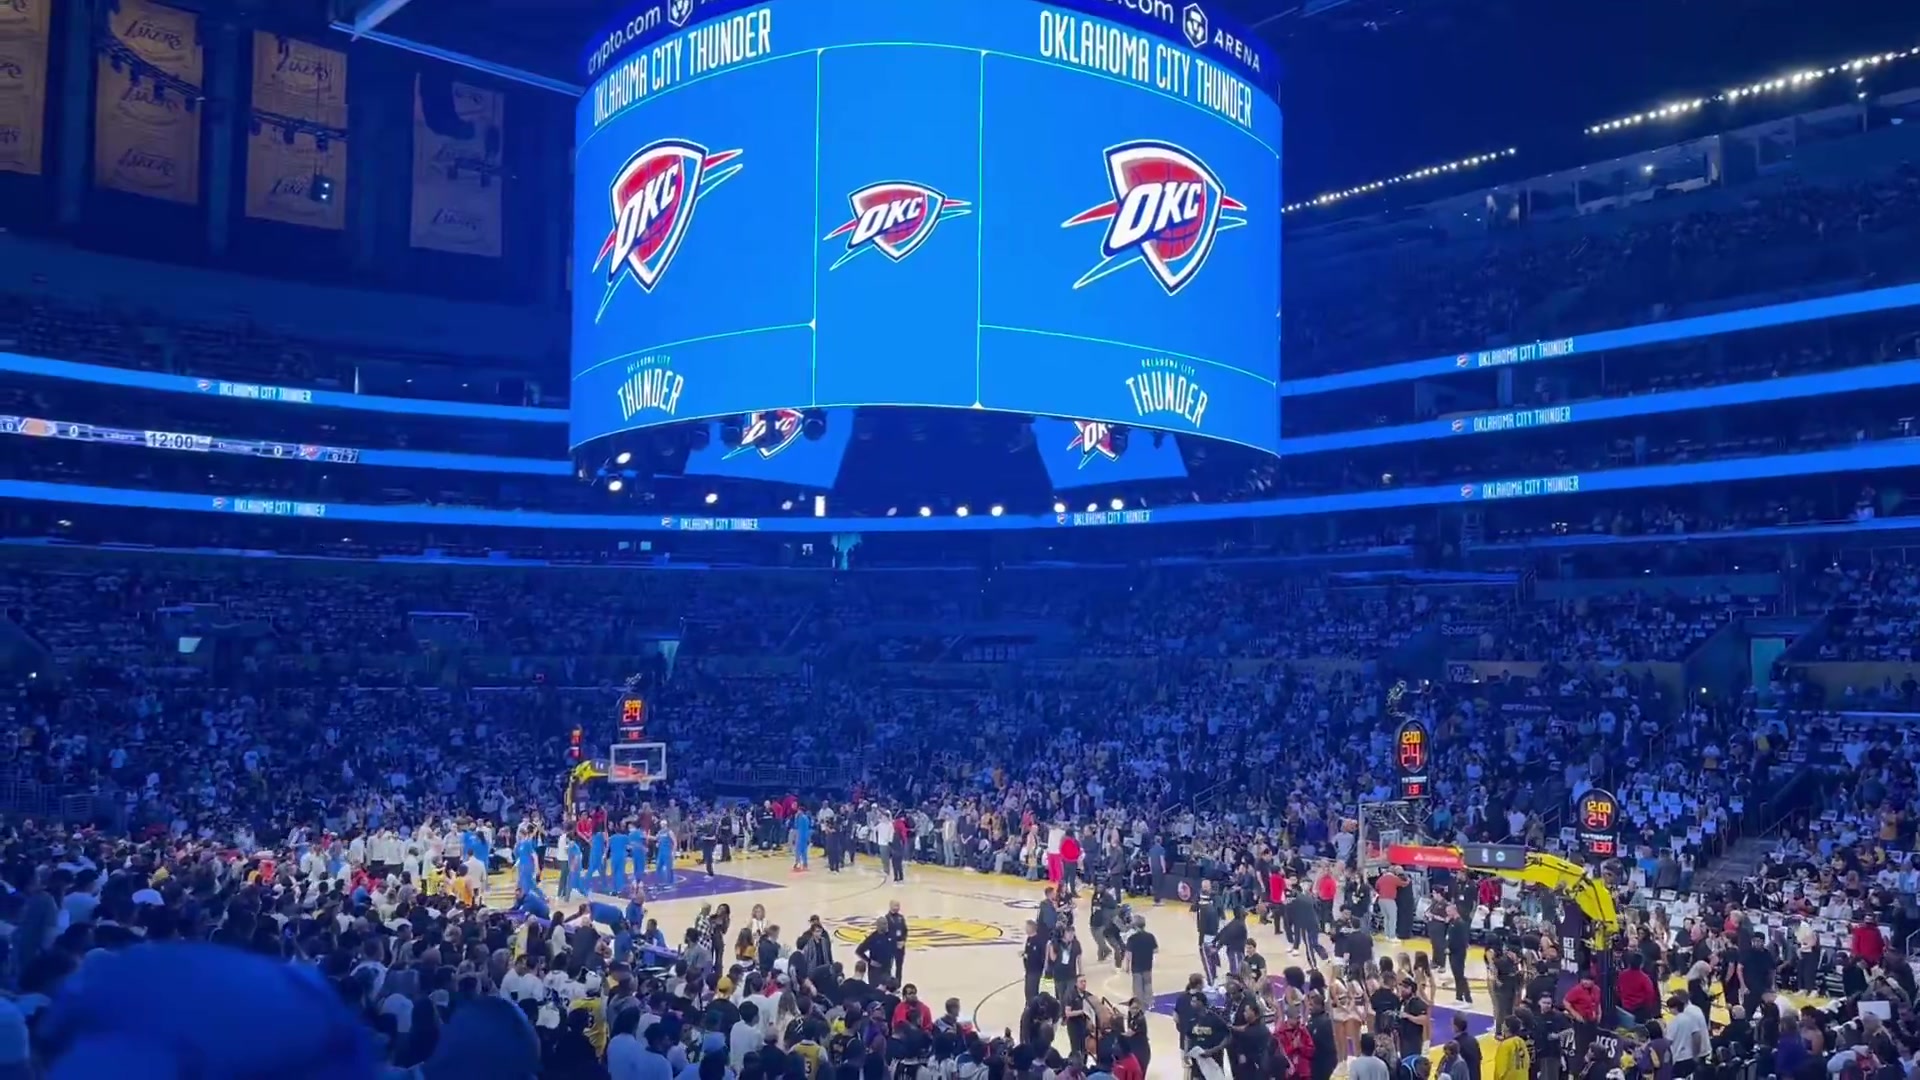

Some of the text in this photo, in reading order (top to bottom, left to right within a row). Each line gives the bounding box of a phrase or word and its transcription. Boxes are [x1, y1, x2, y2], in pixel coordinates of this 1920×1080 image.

[588, 6, 661, 75] crypto.com
[1213, 28, 1260, 72] ARENA
[594, 8, 771, 126] OKLAHOMA CITY THUNDER
[1040, 10, 1252, 129] OKLAHOMA CITY THUNDER
[611, 162, 680, 274] OKC
[850, 196, 924, 246] OKC
[1109, 181, 1202, 250] OKC
[1478, 337, 1574, 367] OKLAHOMA CITY THUNDER
[617, 368, 684, 422] THUNDER
[1125, 371, 1209, 428] THUNDER
[1473, 406, 1571, 432] OKLAHOMA CITY THUNDER
[150, 432, 194, 449] 12:00
[1482, 475, 1579, 499] OKLAHOMA CITY THUNDER
[715, 518, 729, 530] CITY
[1107, 511, 1122, 525] CITY
[623, 708, 641, 722] 24
[1402, 744, 1420, 766] 24
[1587, 801, 1612, 814] 12:00
[1588, 812, 1608, 828] 24
